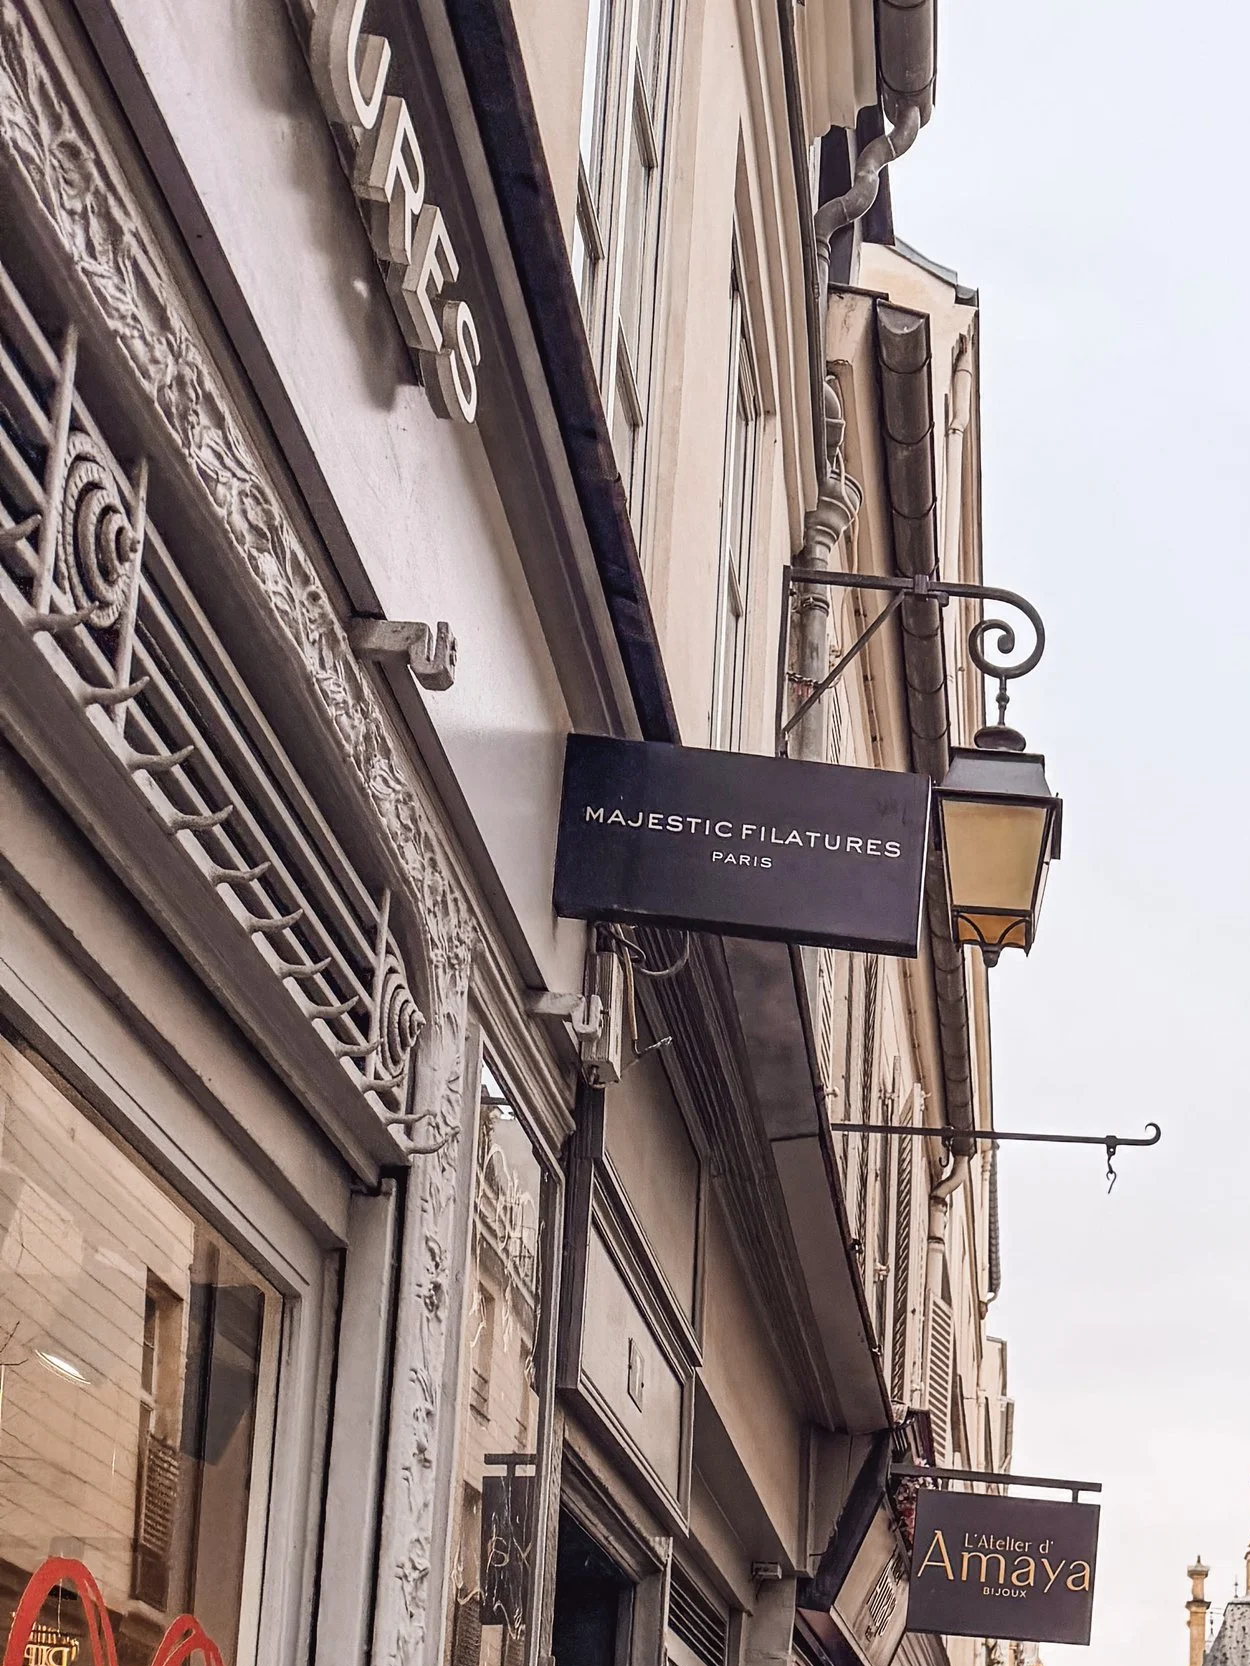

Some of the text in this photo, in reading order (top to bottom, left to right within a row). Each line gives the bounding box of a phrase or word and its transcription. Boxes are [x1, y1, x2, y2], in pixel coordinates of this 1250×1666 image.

[585, 806, 902, 859] MAJESTIC FILATURES
[711, 851, 773, 869] PARIS
[917, 1529, 1091, 1594] Amaya
[982, 1586, 1028, 1599] BIJOUX
